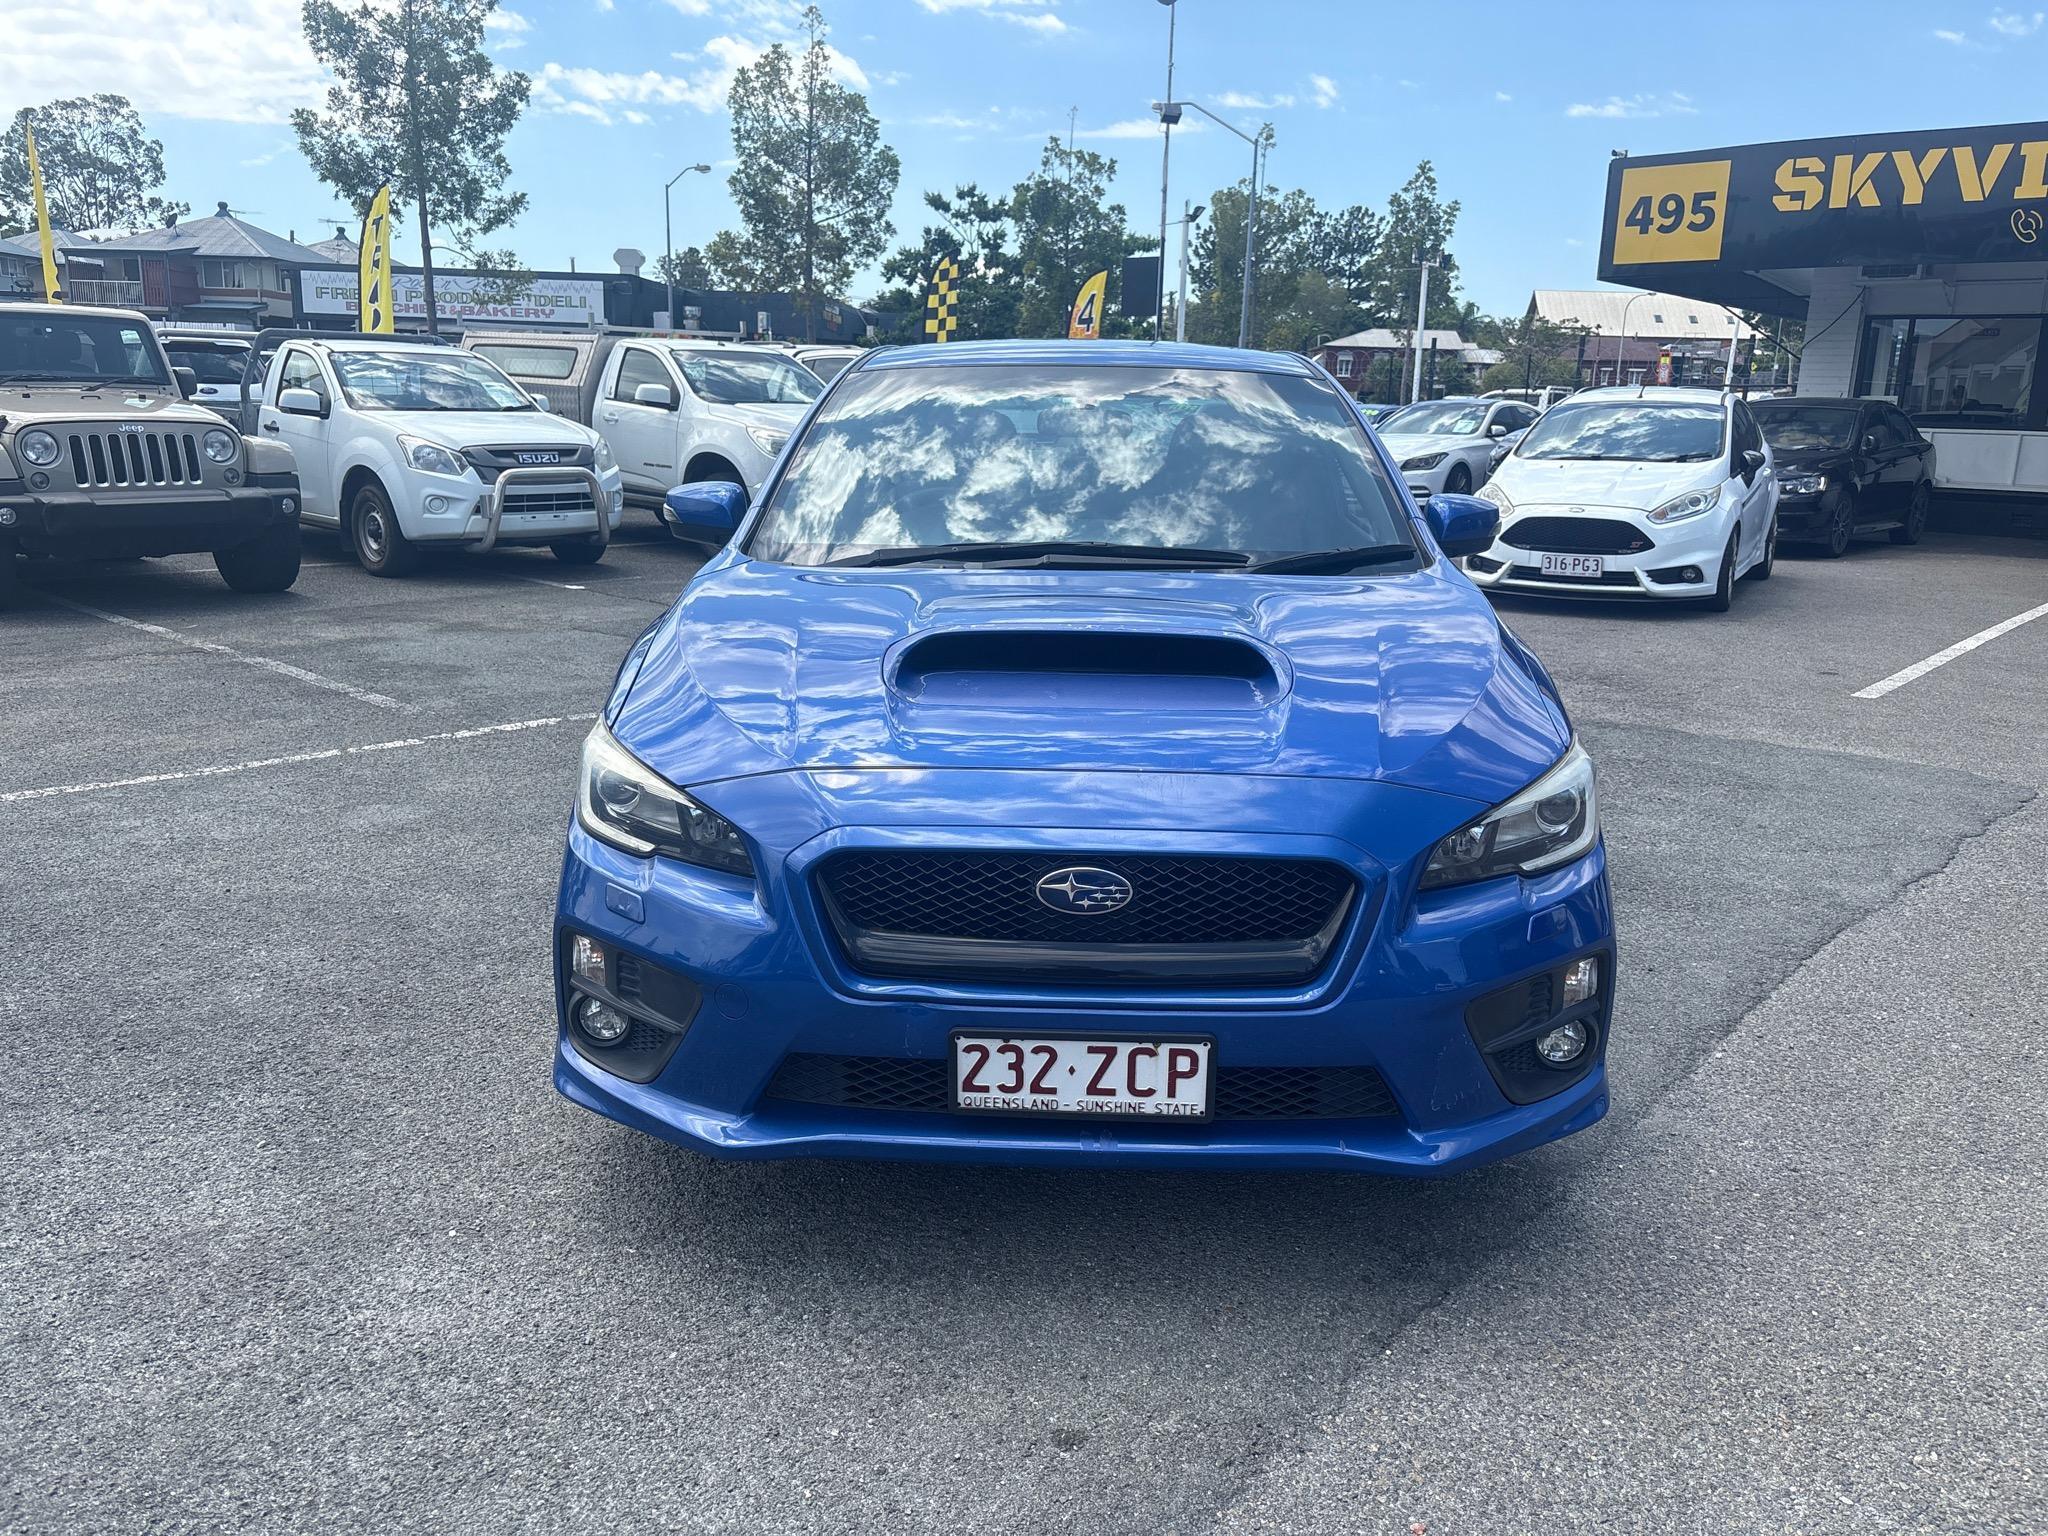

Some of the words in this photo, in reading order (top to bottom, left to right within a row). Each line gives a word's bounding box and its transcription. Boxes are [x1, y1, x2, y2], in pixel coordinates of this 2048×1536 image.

[1624, 191, 1717, 235] 495
[315, 286, 398, 303] FRE
[345, 301, 447, 315] BCHER
[460, 306, 555, 319] BAKERY
[1076, 291, 1097, 334] 4
[118, 423, 145, 433] Jeep
[518, 454, 559, 464] ISUZU
[963, 1096, 1059, 1110] QUEENSLAND
[1076, 1100, 1146, 1113] SUNSHINE
[1154, 1103, 1199, 1115] STATE
